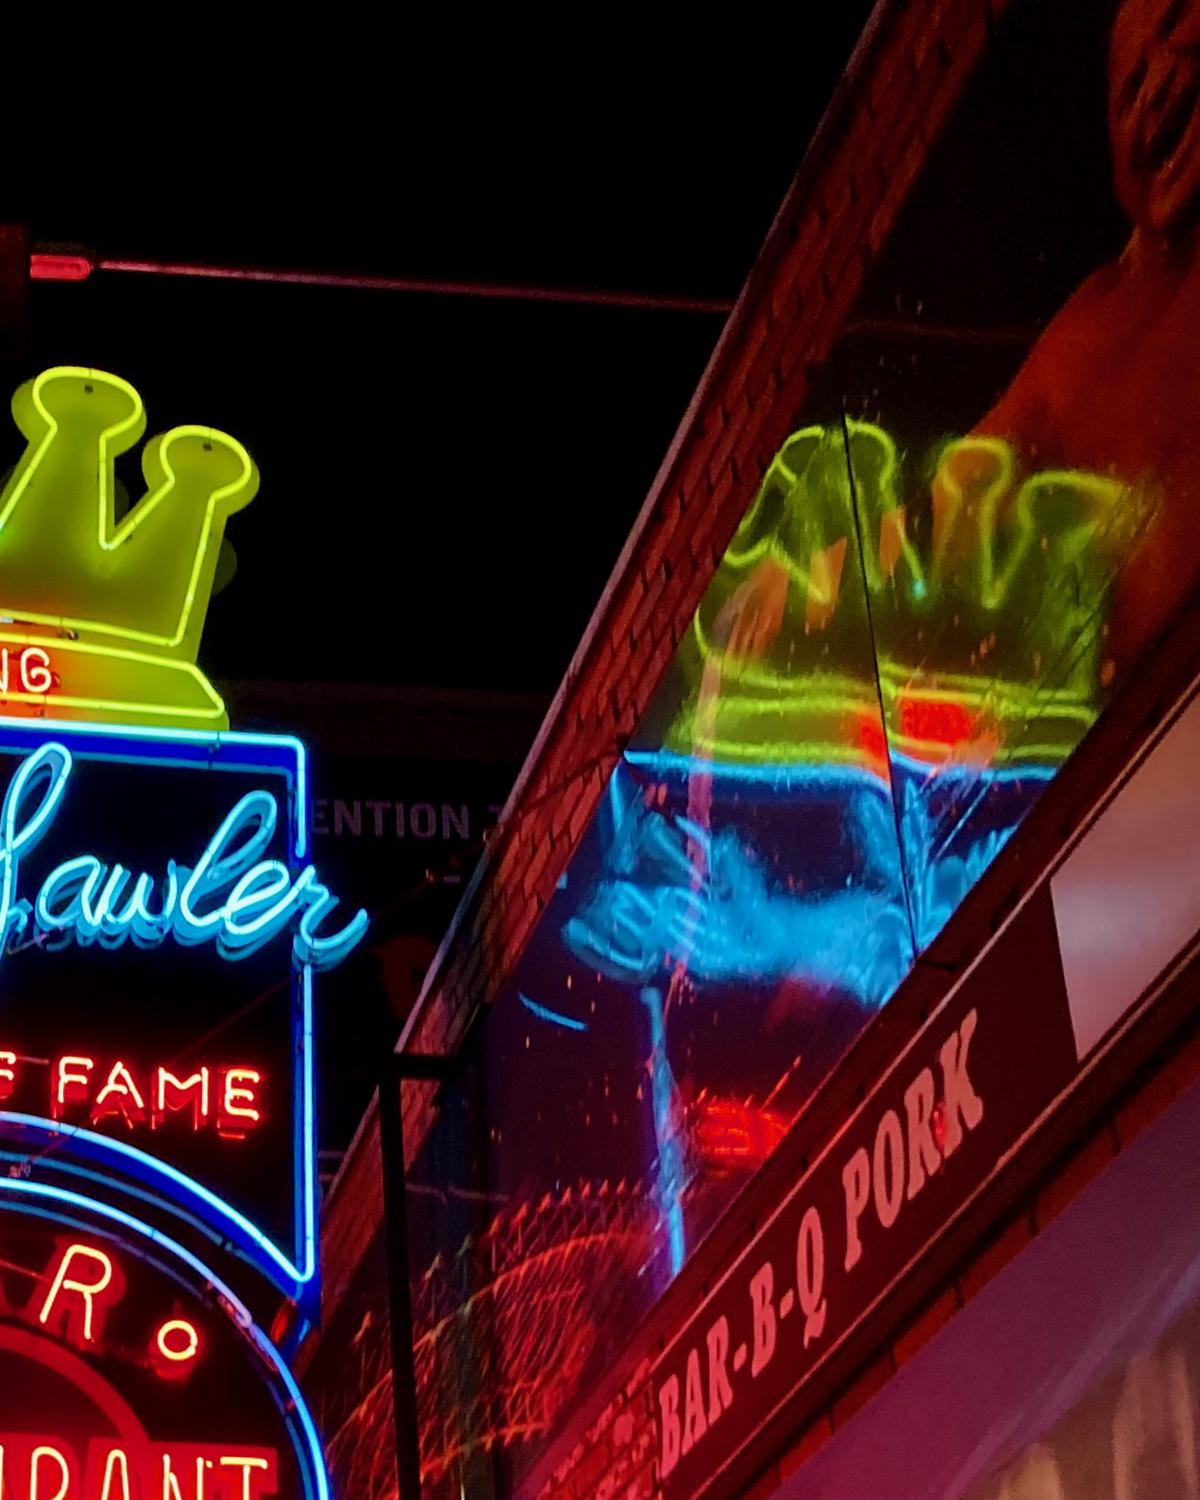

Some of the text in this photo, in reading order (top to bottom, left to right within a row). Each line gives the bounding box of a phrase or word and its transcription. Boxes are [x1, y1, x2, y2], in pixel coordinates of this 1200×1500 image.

[57, 1056, 261, 1122] FAME
[654, 1006, 986, 1482] BAR-B-Q PORK
